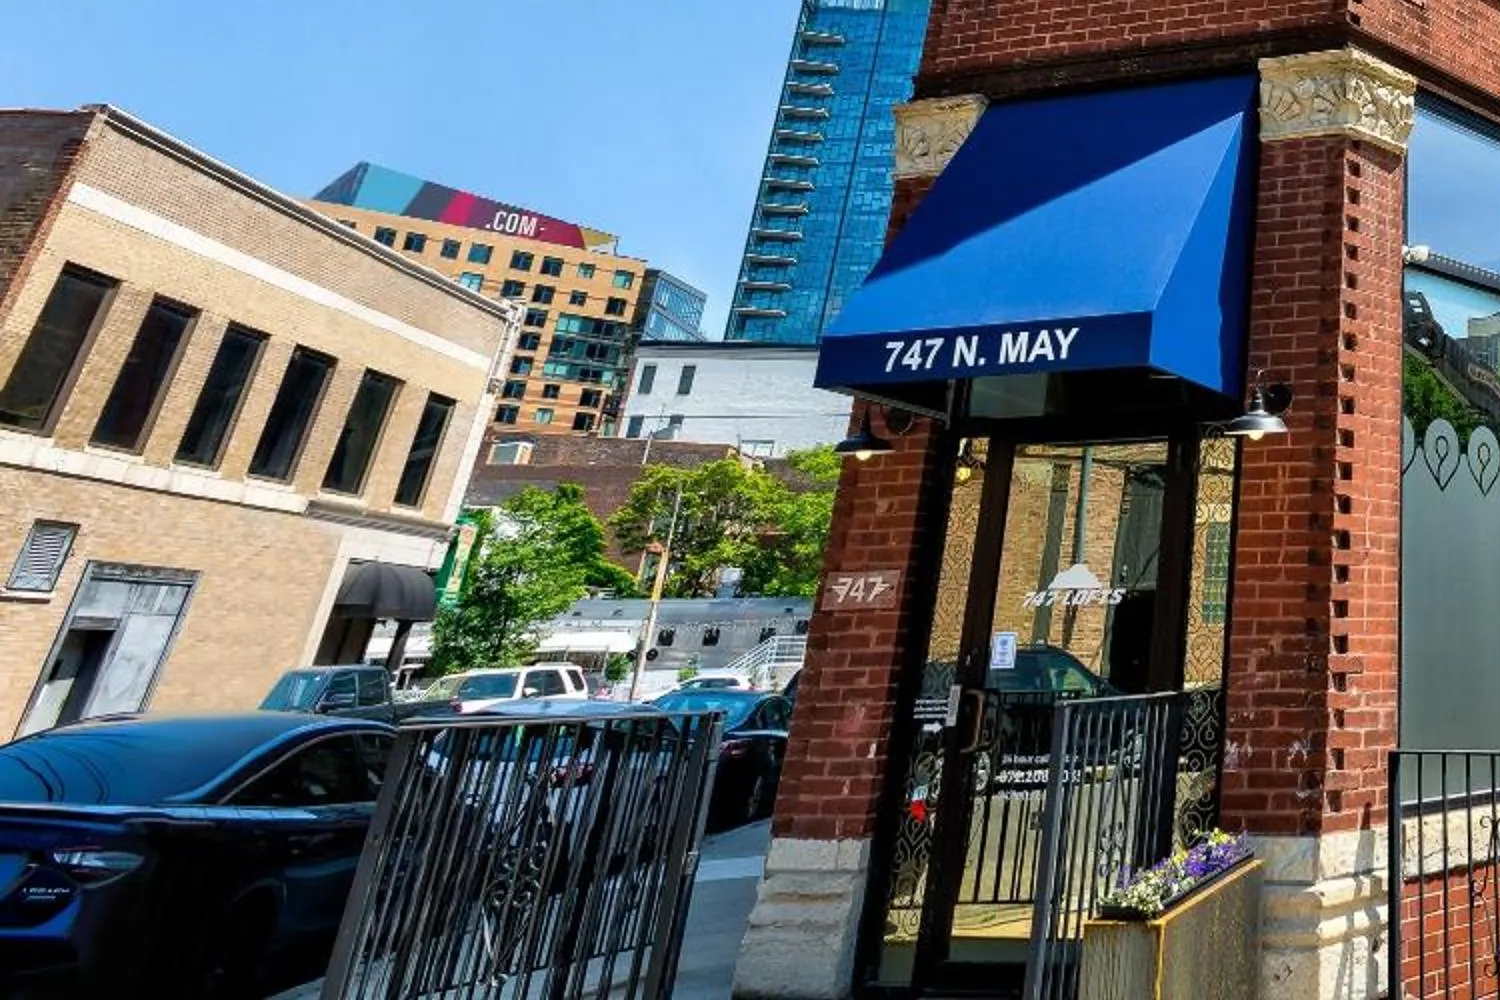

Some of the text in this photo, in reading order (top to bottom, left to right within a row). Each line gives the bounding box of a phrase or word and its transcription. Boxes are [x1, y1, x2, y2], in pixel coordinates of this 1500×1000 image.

[885, 327, 1080, 373] 747 N. MAY
[832, 576, 890, 603] 747
[1063, 587, 1126, 606] LOFTS
